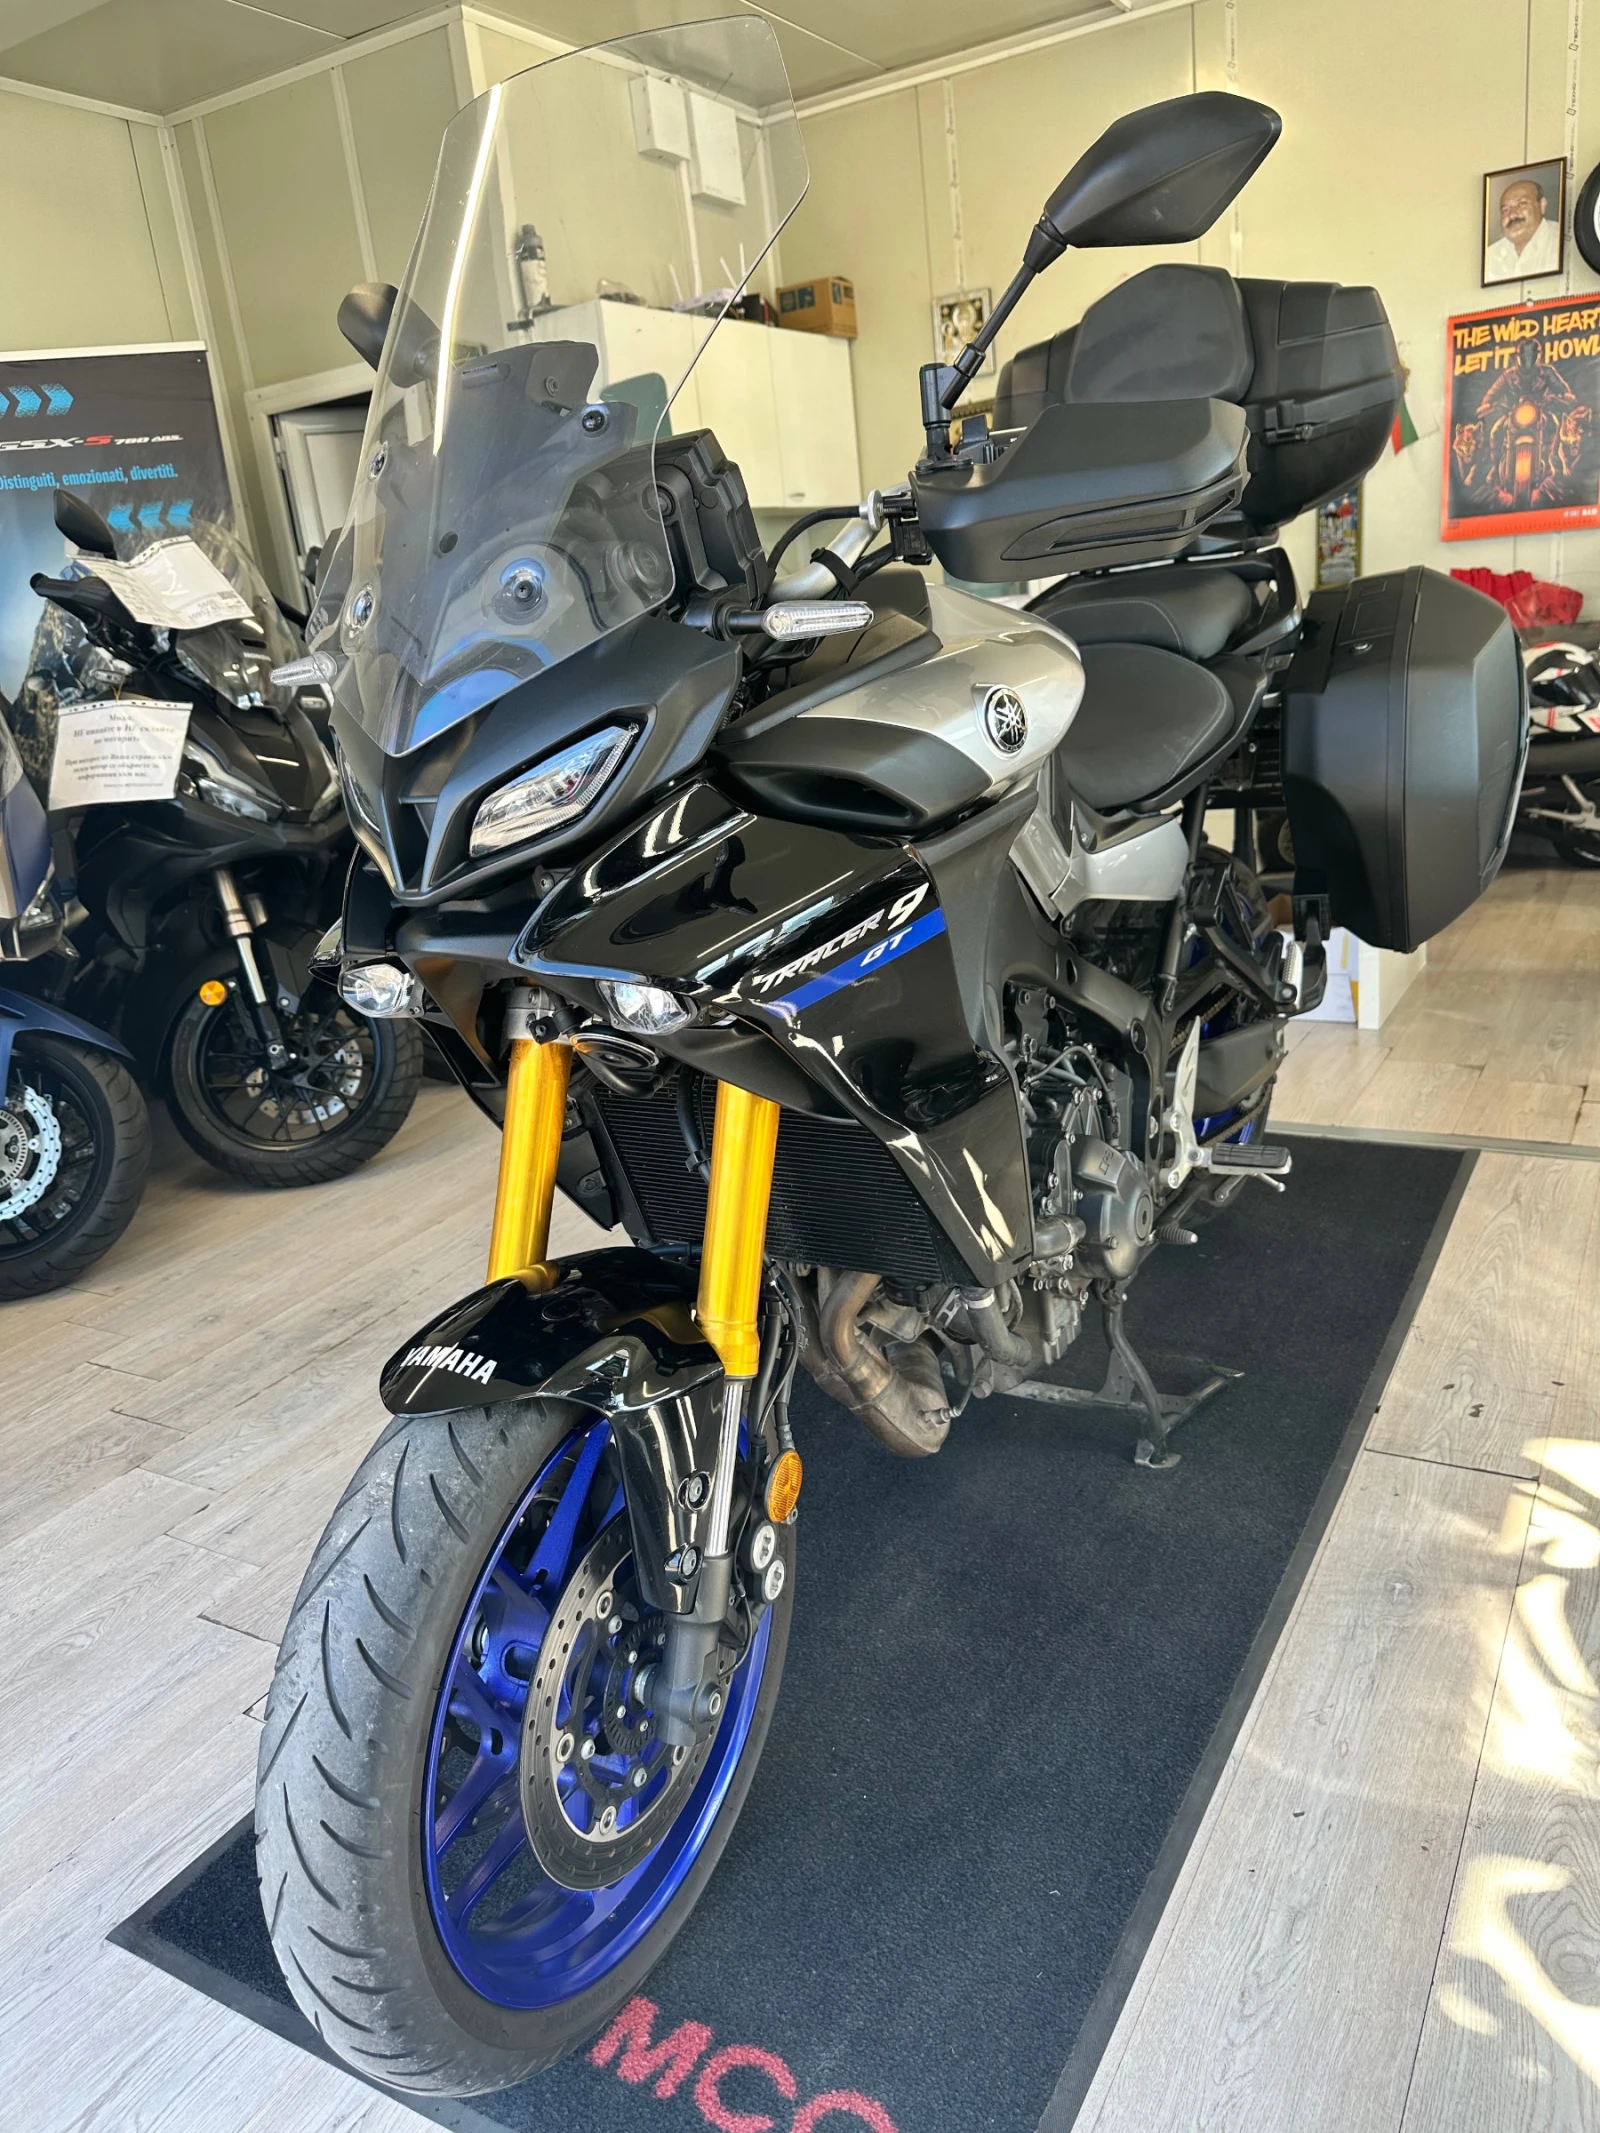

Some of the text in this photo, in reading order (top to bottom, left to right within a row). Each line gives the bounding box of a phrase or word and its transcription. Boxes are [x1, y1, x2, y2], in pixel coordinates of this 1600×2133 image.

[1453, 325, 1492, 349] THE
[1492, 316, 1540, 343] WILD
[1454, 334, 1600, 376] LET IT HOWL
[62, 467, 129, 485] emozionati,
[130, 463, 179, 481] divertiti.
[760, 881, 930, 994] TRACER 9
[860, 926, 913, 967] GT
[400, 1345, 498, 1386] YAMAHA
